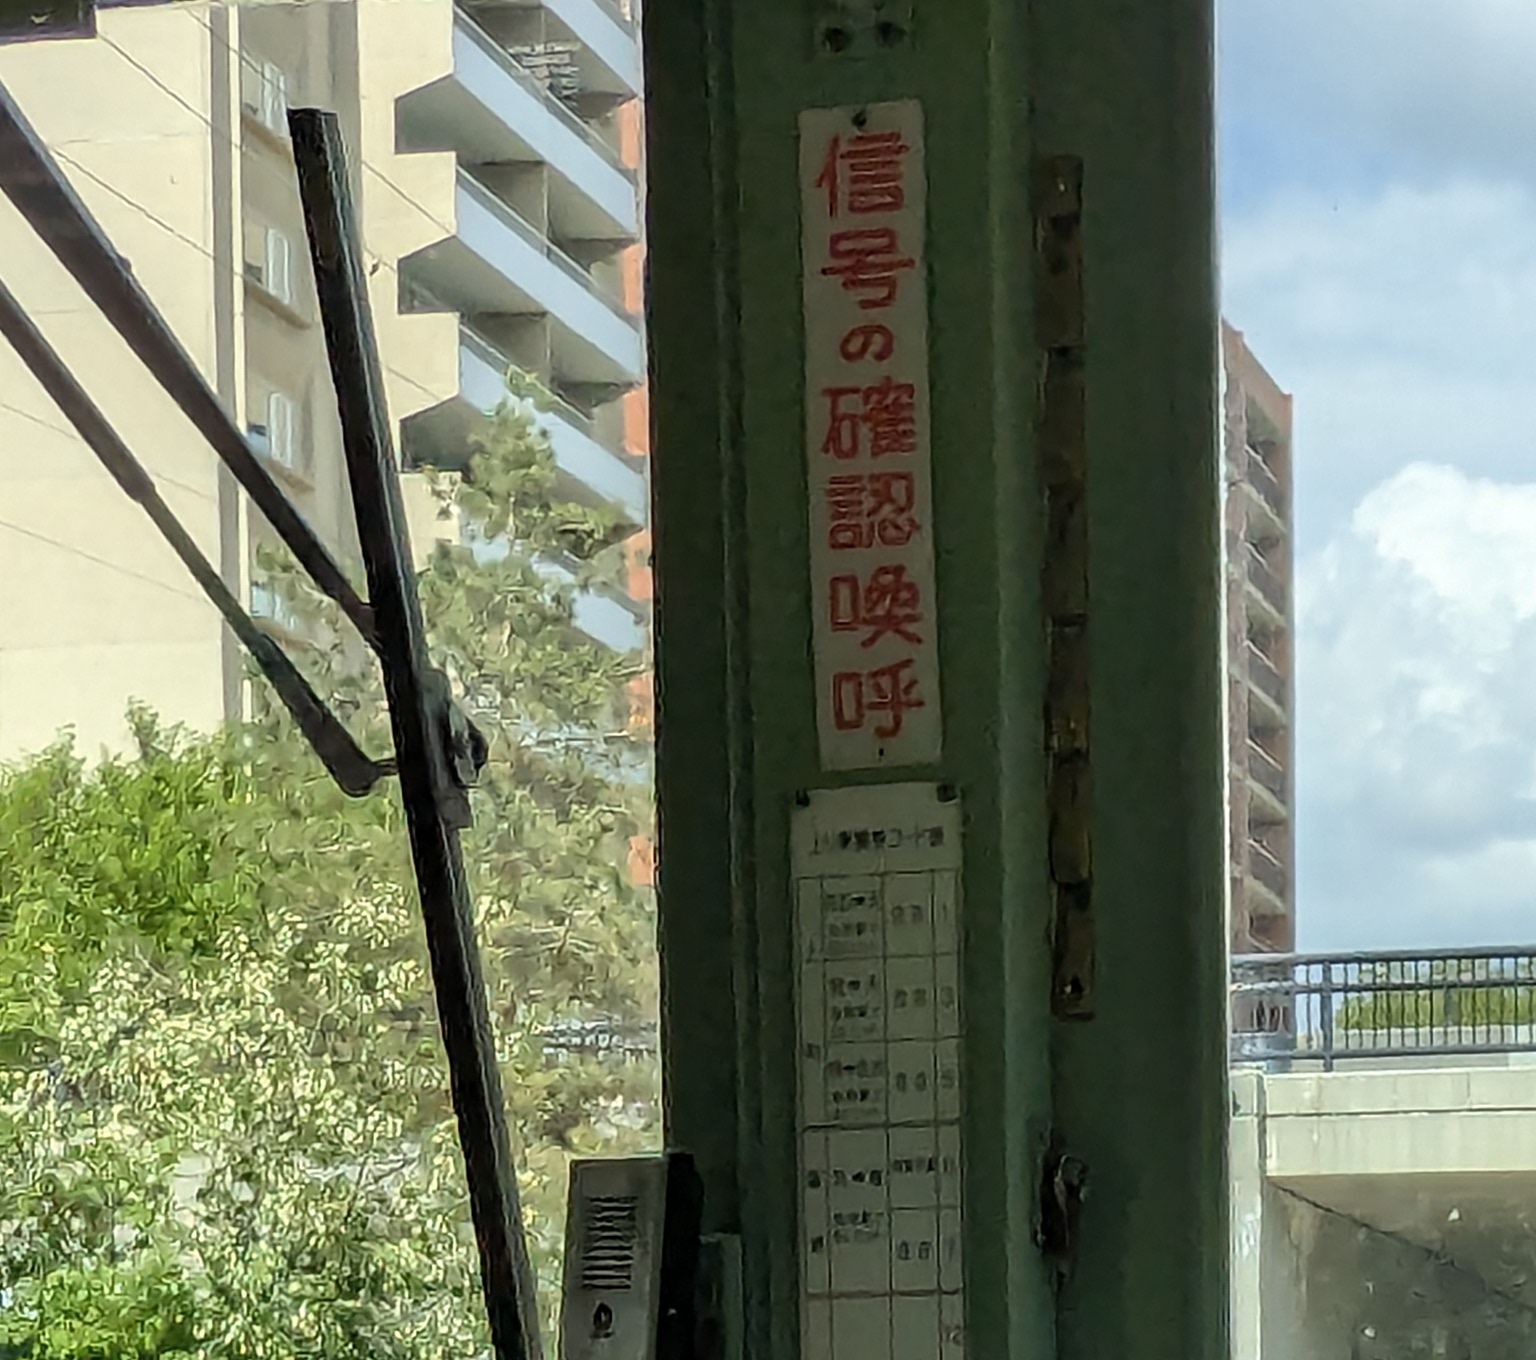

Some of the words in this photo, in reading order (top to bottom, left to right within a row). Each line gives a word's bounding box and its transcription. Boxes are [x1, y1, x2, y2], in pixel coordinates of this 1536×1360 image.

[815, 130, 925, 739] 信号の確認喚呼
